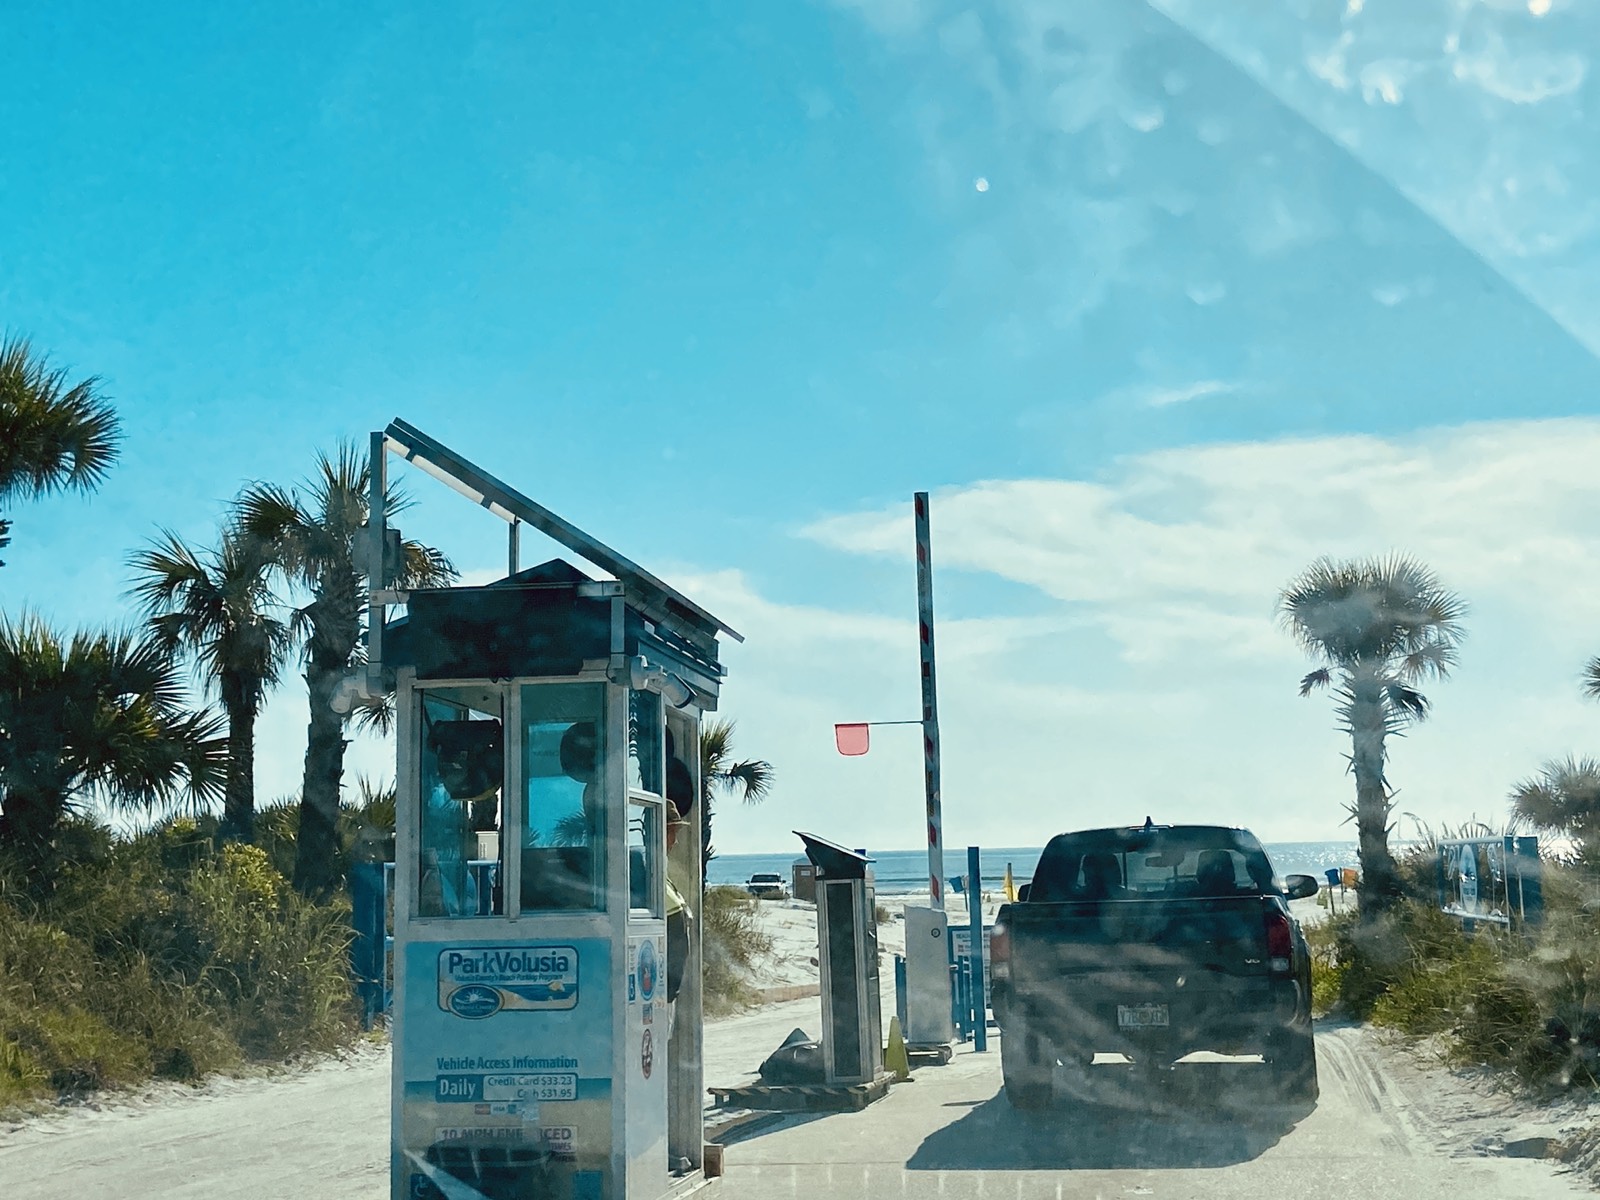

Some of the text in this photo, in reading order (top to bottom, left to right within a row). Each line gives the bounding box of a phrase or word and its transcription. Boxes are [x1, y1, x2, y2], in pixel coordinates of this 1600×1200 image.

[448, 950, 569, 974] ParkVolusia
[436, 1055, 578, 1070] Vehicle Access Information
[440, 1078, 476, 1098] Daily
[487, 1076, 573, 1086] Credit Card $33.23
[517, 1088, 572, 1098] Cah $31.95
